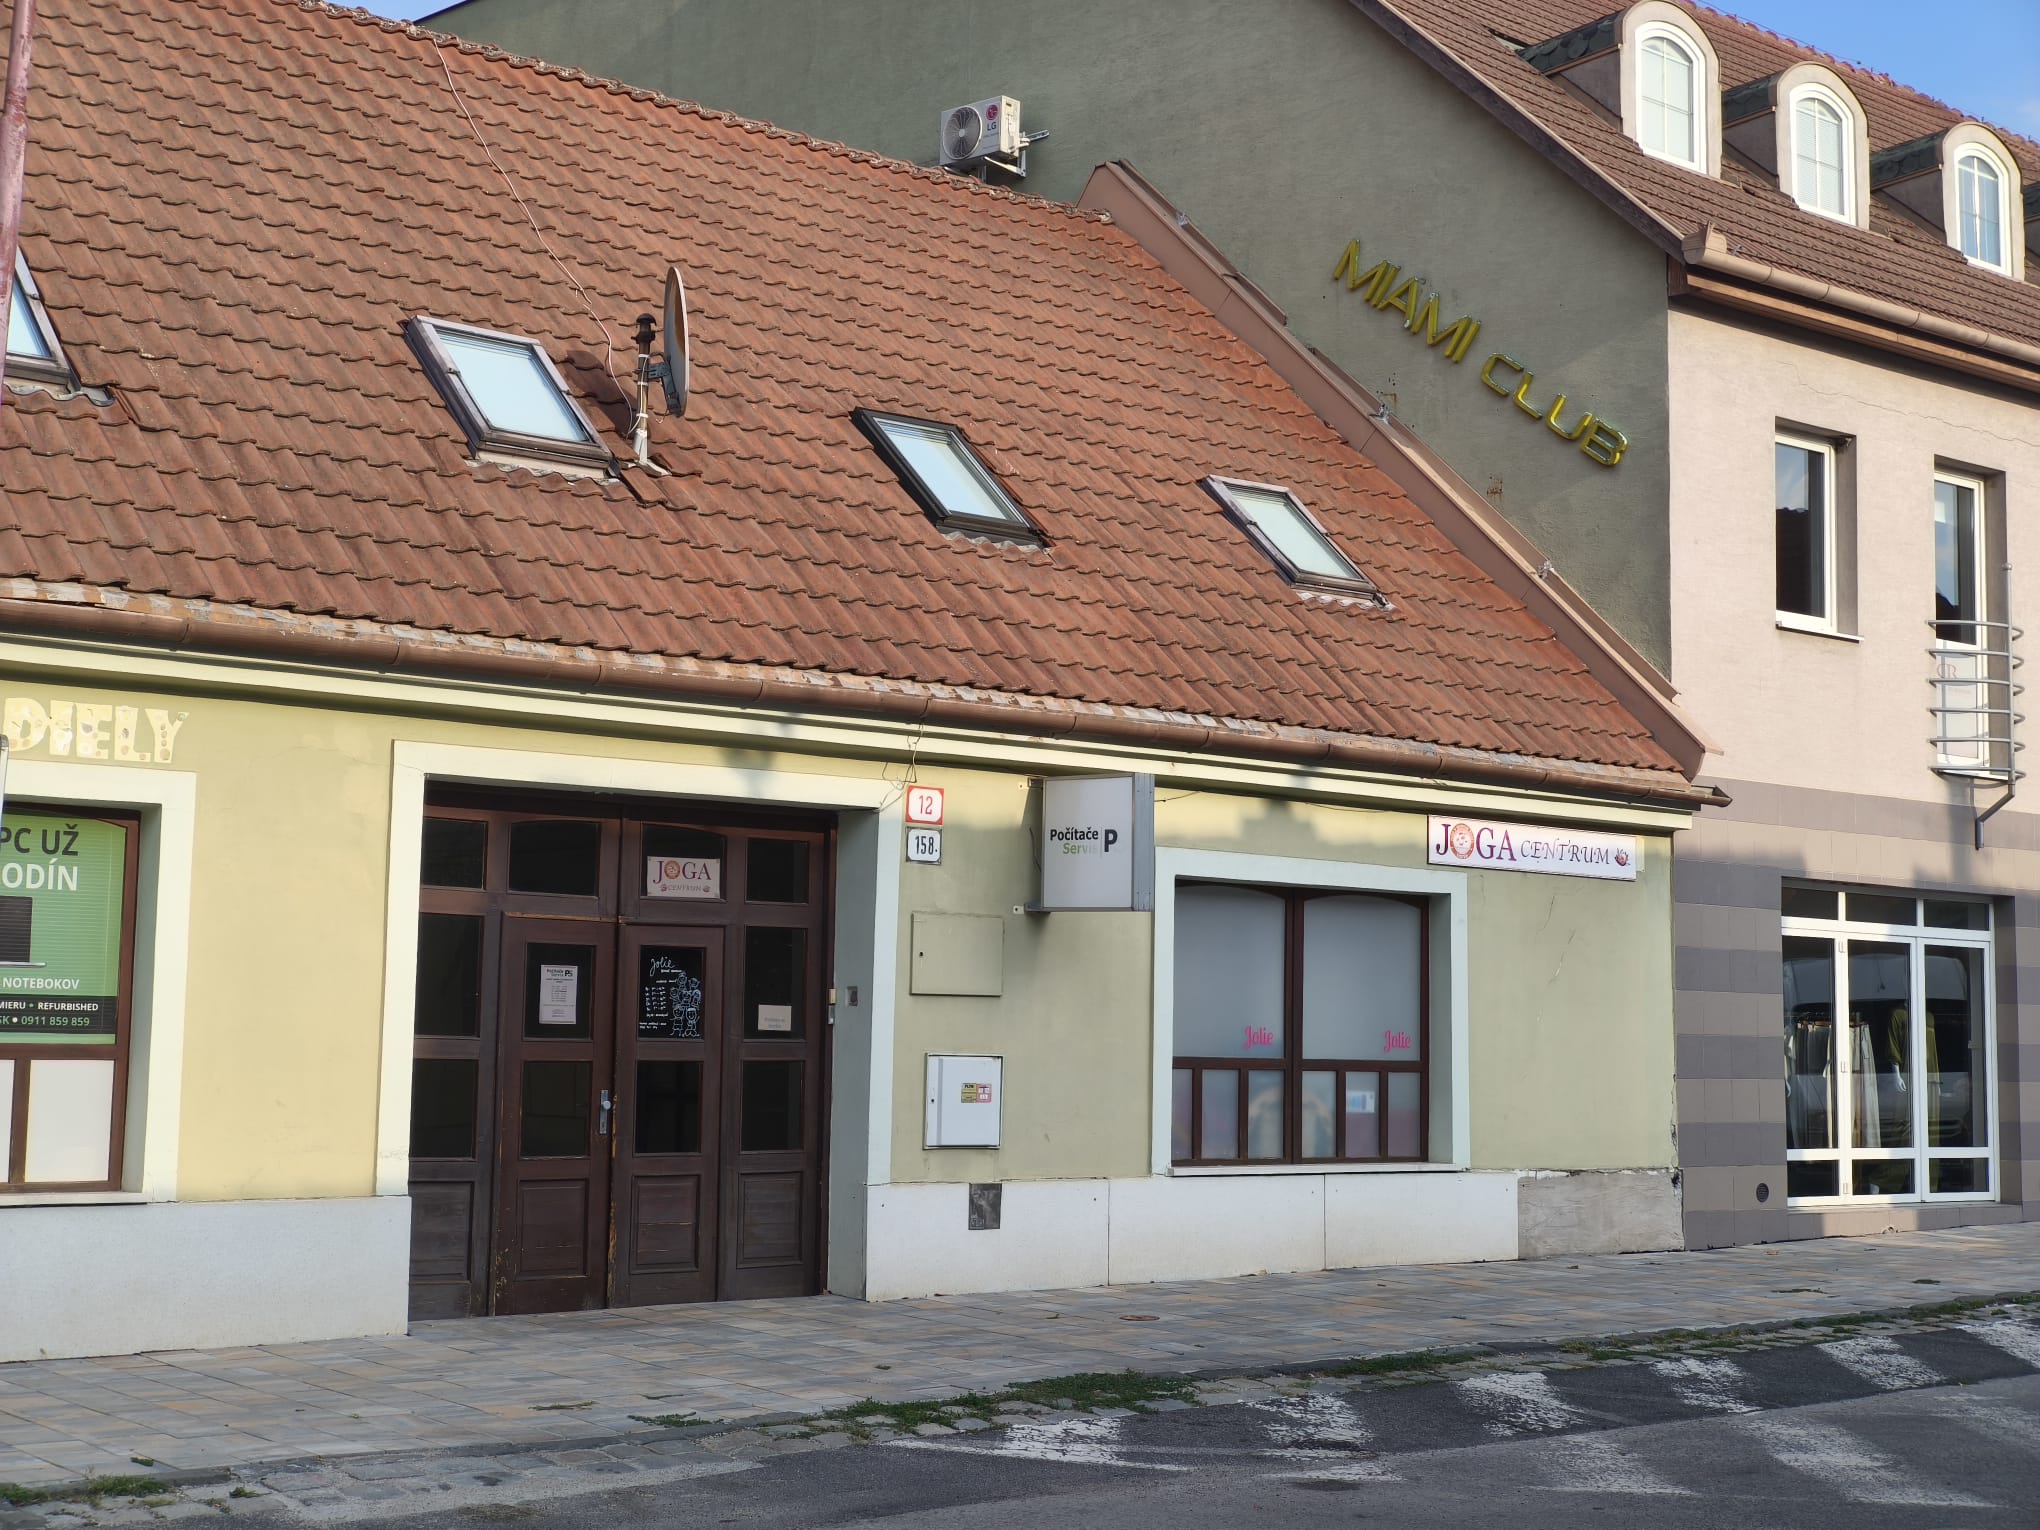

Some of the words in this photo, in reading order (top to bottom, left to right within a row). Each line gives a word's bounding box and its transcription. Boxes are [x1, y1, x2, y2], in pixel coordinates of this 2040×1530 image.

[987, 121, 997, 131] LG
[1332, 238, 1482, 364] MIAMI
[1479, 351, 1630, 467] CLUB
[3, 697, 190, 764] DIELY
[918, 794, 933, 815] 12
[0, 826, 32, 854] PC
[41, 823, 79, 856] UŽ
[1050, 826, 1099, 841] Počítače
[1435, 822, 1517, 862] JOGA
[1520, 838, 1610, 865] CENTRUM
[652, 859, 712, 885] JOGA
[2, 976, 81, 990] NOTEBOKOV
[37, 1002, 99, 1012] REFURBISHED
[21, 1015, 46, 1025] 0911
[49, 1016, 69, 1026] 859
[71, 1017, 90, 1027] 859
[1243, 1024, 1275, 1051] Jolie
[1382, 1029, 1412, 1053] Jolie
